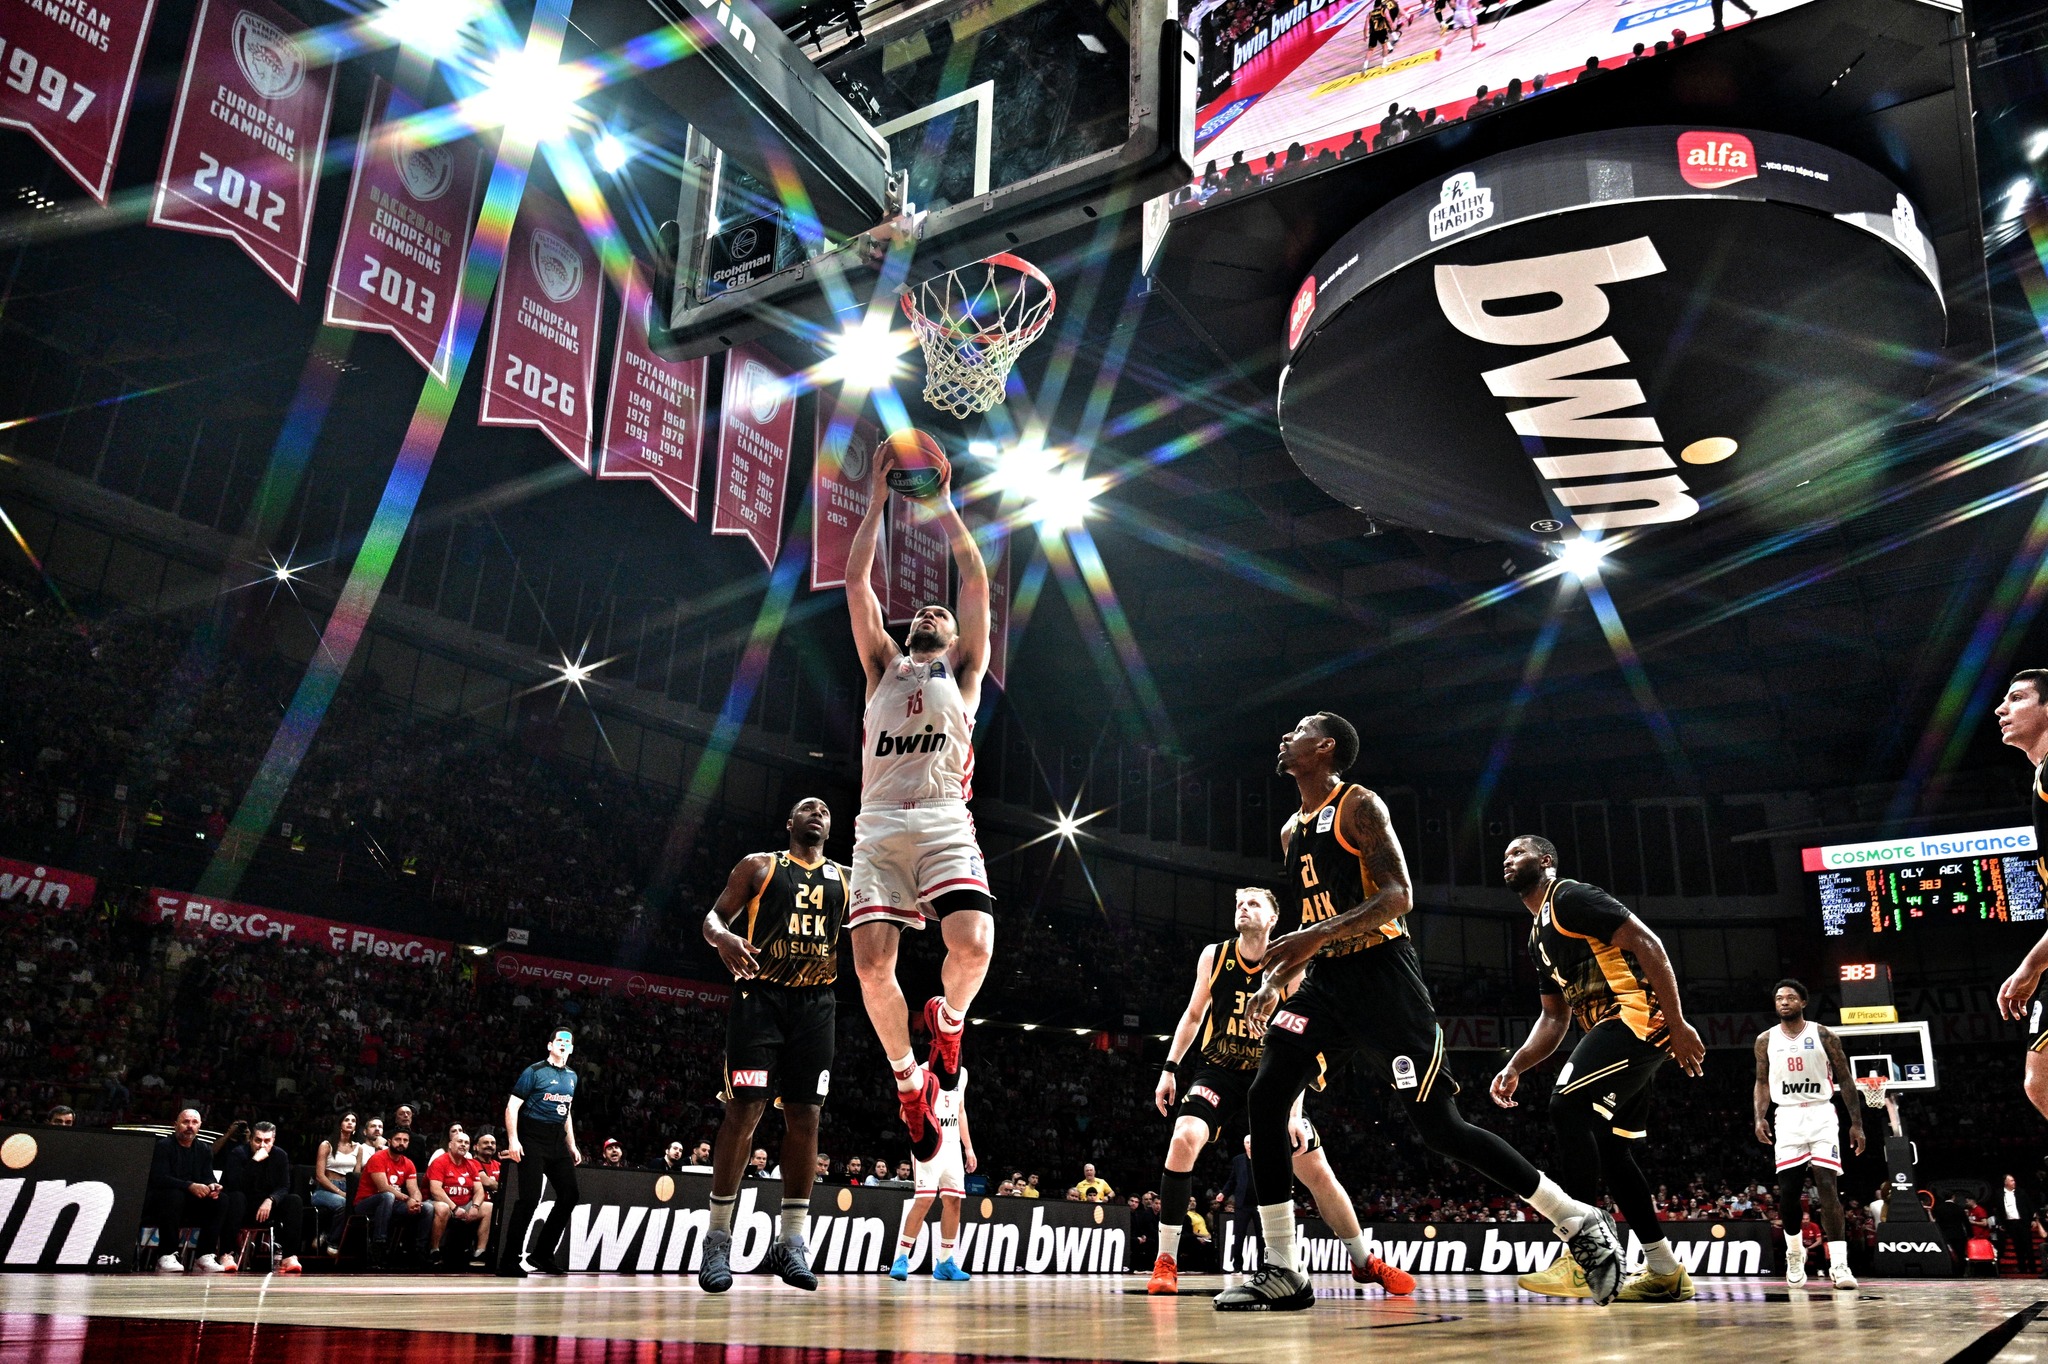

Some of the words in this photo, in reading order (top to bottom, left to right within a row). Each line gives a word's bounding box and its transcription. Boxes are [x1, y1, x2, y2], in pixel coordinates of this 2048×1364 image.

[25, 0, 110, 53] AMPIONS
[57, 0, 111, 32] PEAN
[1233, 26, 1269, 71] bwin
[1271, 0, 1307, 41] bwin
[217, 85, 295, 144] EUROPEAN
[210, 100, 295, 162] CHAMPIONS
[1686, 141, 1749, 168] alfa
[193, 151, 286, 233] 2012
[1433, 193, 1484, 222] HEALTHY
[370, 185, 452, 248] BACK2BACK
[1434, 206, 1485, 235] HABITS
[369, 222, 441, 276] CHAMPIONS
[375, 208, 441, 258] EUROPEAN
[713, 253, 772, 283] Stoiximan
[726, 271, 755, 290] GBL
[359, 254, 436, 325] 2013
[517, 309, 579, 355] CHAMPIONS
[522, 295, 578, 338] EUROPEAN
[505, 353, 575, 417] 2026
[636, 372, 682, 409] ΕΛΛΑΔΑΣ
[1434, 235, 1738, 532] bwin
[627, 406, 650, 428] 1976
[661, 424, 684, 445] 1978
[629, 391, 652, 413] 1949
[663, 410, 686, 431] 1960
[625, 422, 648, 443] 1993
[660, 440, 683, 461] 1994
[641, 446, 664, 467] 1995
[730, 467, 748, 486] 2012
[756, 484, 773, 504] 2015
[732, 452, 749, 473] 1996
[758, 469, 774, 489] 1997
[729, 482, 747, 502] 2016
[754, 499, 772, 518] 2022
[740, 504, 758, 525] 2023
[831, 494, 867, 517] ΕΛΛΑΔΑ
[827, 511, 848, 528] 2025
[875, 724, 947, 757] bwin
[1831, 845, 1916, 865] COSMOTE
[1921, 833, 2031, 857] Insurance
[1300, 853, 1320, 889] 21
[1901, 867, 1924, 879] OLY
[1939, 864, 1963, 876] AEK
[795, 883, 824, 910] 24
[1301, 890, 1337, 924] AEK
[1906, 895, 1922, 906] 44
[1932, 895, 1940, 905] 2
[183, 900, 296, 942] FlexCar
[788, 912, 827, 937] AEK
[351, 929, 447, 967] FlexCar
[790, 941, 829, 957] SUNE
[520, 964, 574, 981] NEVER
[577, 974, 613, 987] QUIT
[647, 984, 695, 999] NEVER
[698, 991, 730, 1004] QUIT
[1277, 1011, 1308, 1034] VIS
[1856, 1010, 1888, 1020] Piraeus
[1229, 1042, 1265, 1058] SUNE
[1787, 1056, 1804, 1072] 88
[733, 1070, 768, 1087] AVIS
[1782, 1078, 1822, 1095] bwin
[944, 1094, 950, 1108] 5
[1200, 1086, 1220, 1108] VIS
[1025, 1205, 1131, 1274] bwin
[1878, 1241, 1943, 1253] NOVA
[97, 1254, 122, 1265] 21+
